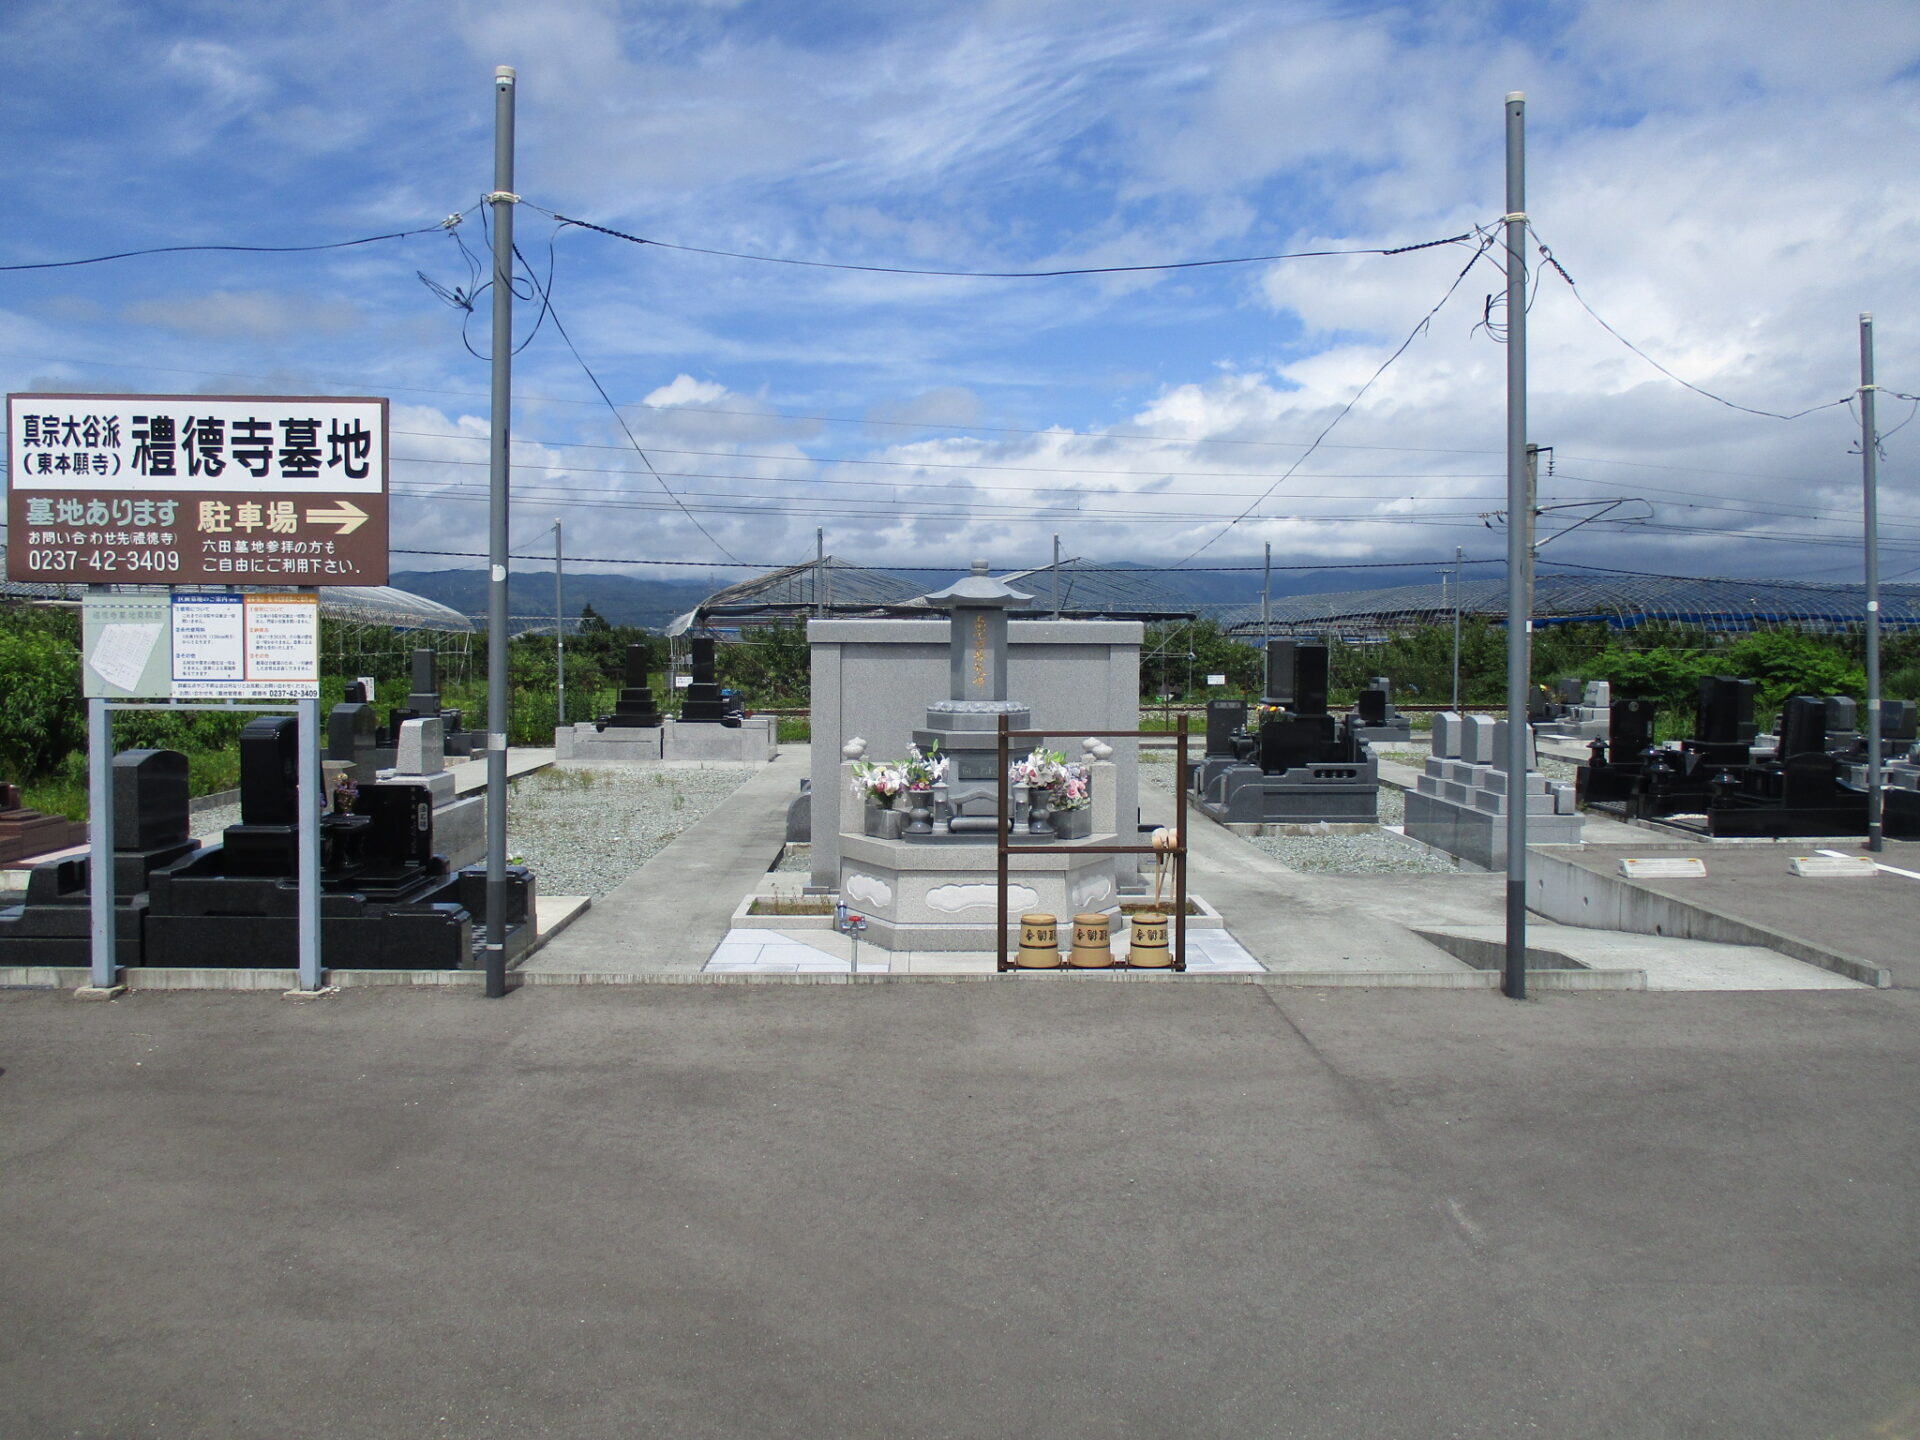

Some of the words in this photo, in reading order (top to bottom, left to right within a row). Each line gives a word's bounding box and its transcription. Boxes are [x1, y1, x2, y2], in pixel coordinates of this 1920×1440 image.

[23, 415, 121, 448] 真宗大谷派
[26, 498, 179, 526] 墓地あります
[197, 501, 298, 533] 駐車場
[29, 550, 179, 571] 0237-42-3409
[202, 540, 335, 554] 六田墓地参拝の方も
